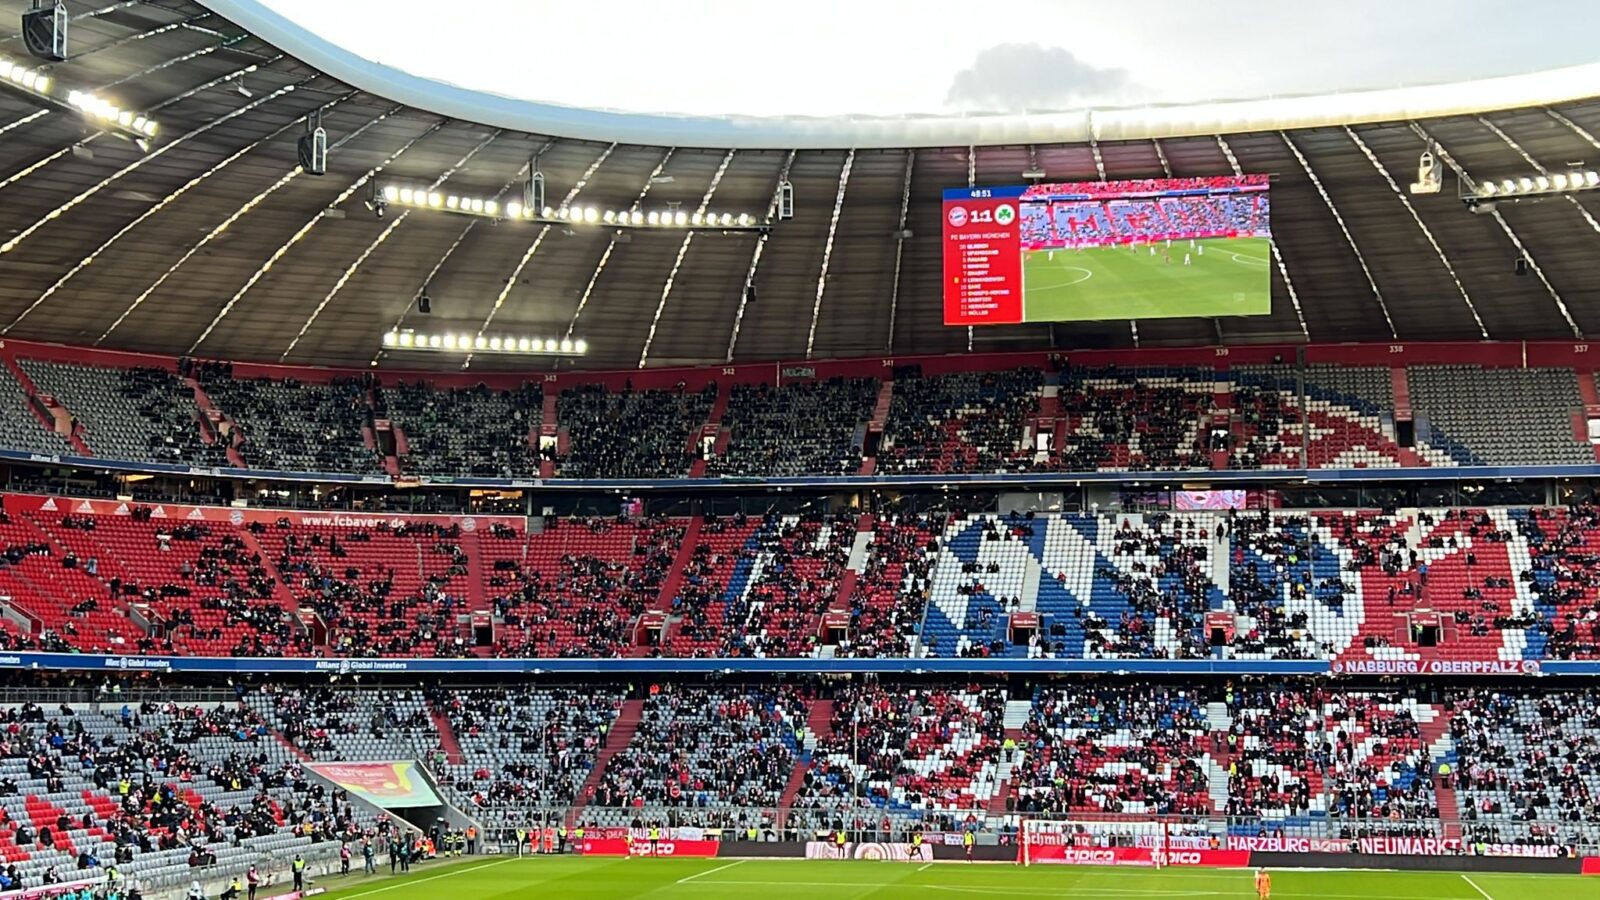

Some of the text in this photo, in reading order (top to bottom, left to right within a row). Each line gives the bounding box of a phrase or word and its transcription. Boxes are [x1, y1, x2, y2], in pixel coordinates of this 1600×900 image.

[970, 209, 992, 223] 1:1
[1215, 348, 1229, 356] 339
[1574, 344, 1589, 353] 337
[882, 359, 894, 367] 341
[722, 368, 736, 376] 342
[544, 374, 558, 382] 343
[315, 661, 340, 669] Allianz
[351, 661, 373, 669] Global
[1345, 660, 1519, 673] NABBURG / OBERPFALZ
[1227, 837, 1309, 853] HARZBURG
[1361, 837, 1461, 856] NEUMARKT
[1064, 849, 1115, 863] tipico
[1150, 851, 1201, 864] tipico
